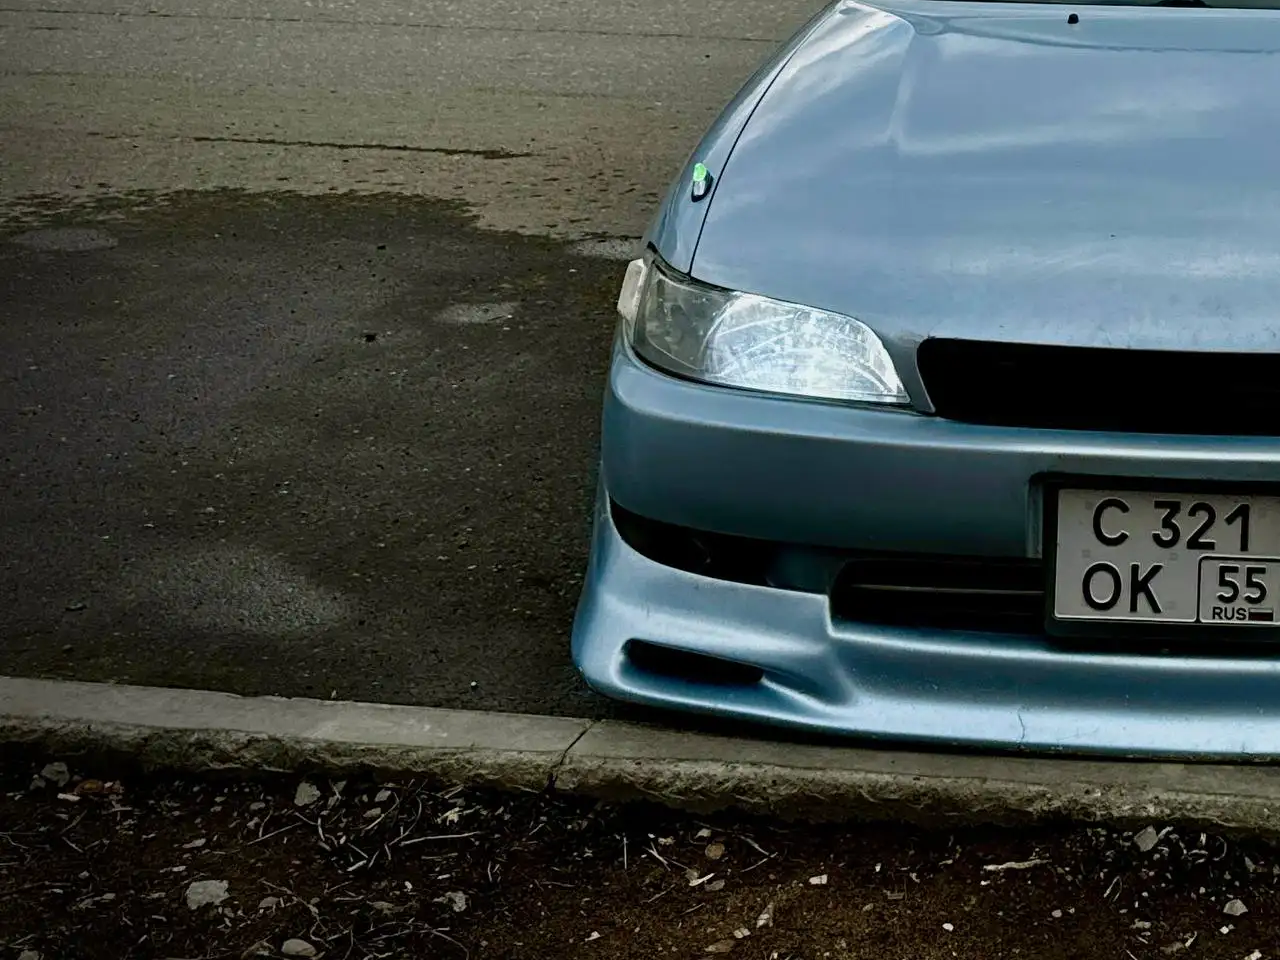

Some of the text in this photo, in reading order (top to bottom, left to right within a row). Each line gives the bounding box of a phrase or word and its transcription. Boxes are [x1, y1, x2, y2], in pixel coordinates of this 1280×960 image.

[1093, 498, 1250, 552] С 321
[1082, 563, 1164, 614] ОК
[1216, 564, 1267, 604] 55
[1212, 607, 1247, 621] RUS
